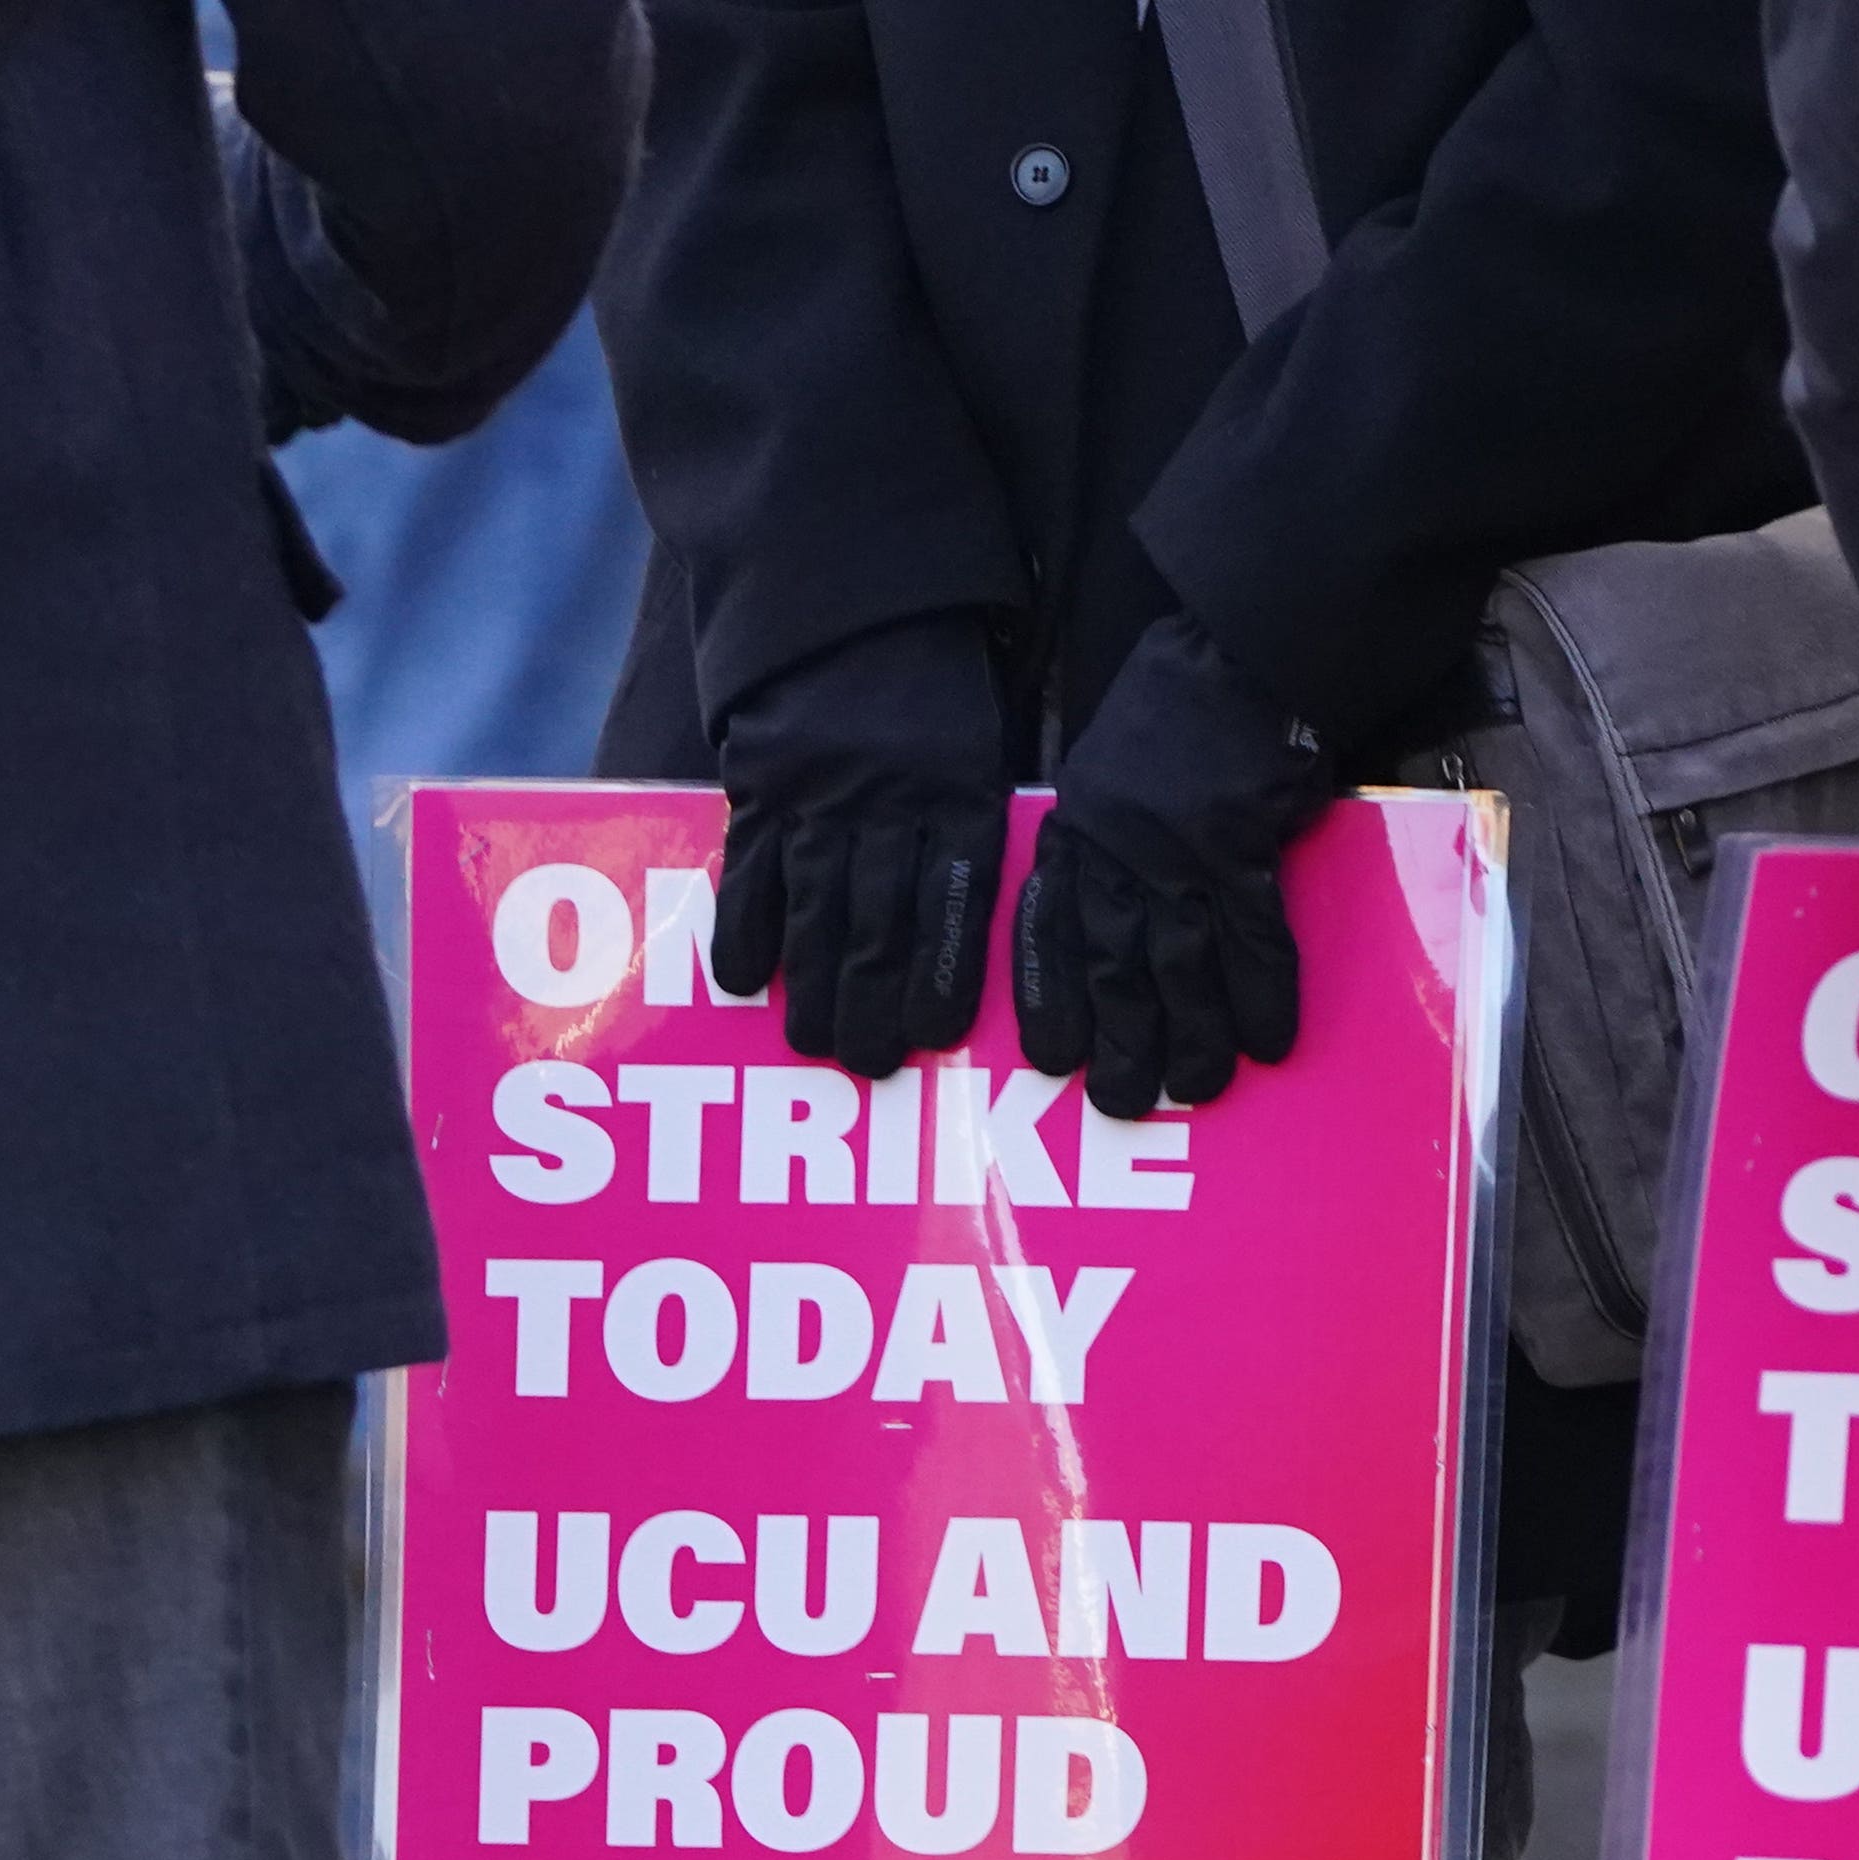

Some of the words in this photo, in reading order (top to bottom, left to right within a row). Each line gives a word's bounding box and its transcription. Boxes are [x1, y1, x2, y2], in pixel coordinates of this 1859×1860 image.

[490, 1060, 1194, 1210] STRIKE
[486, 1257, 1136, 1405] TODAY
[484, 1510, 879, 1655] UCU
[912, 1516, 1341, 1662] AND
[478, 1706, 1147, 1855] PROUD
